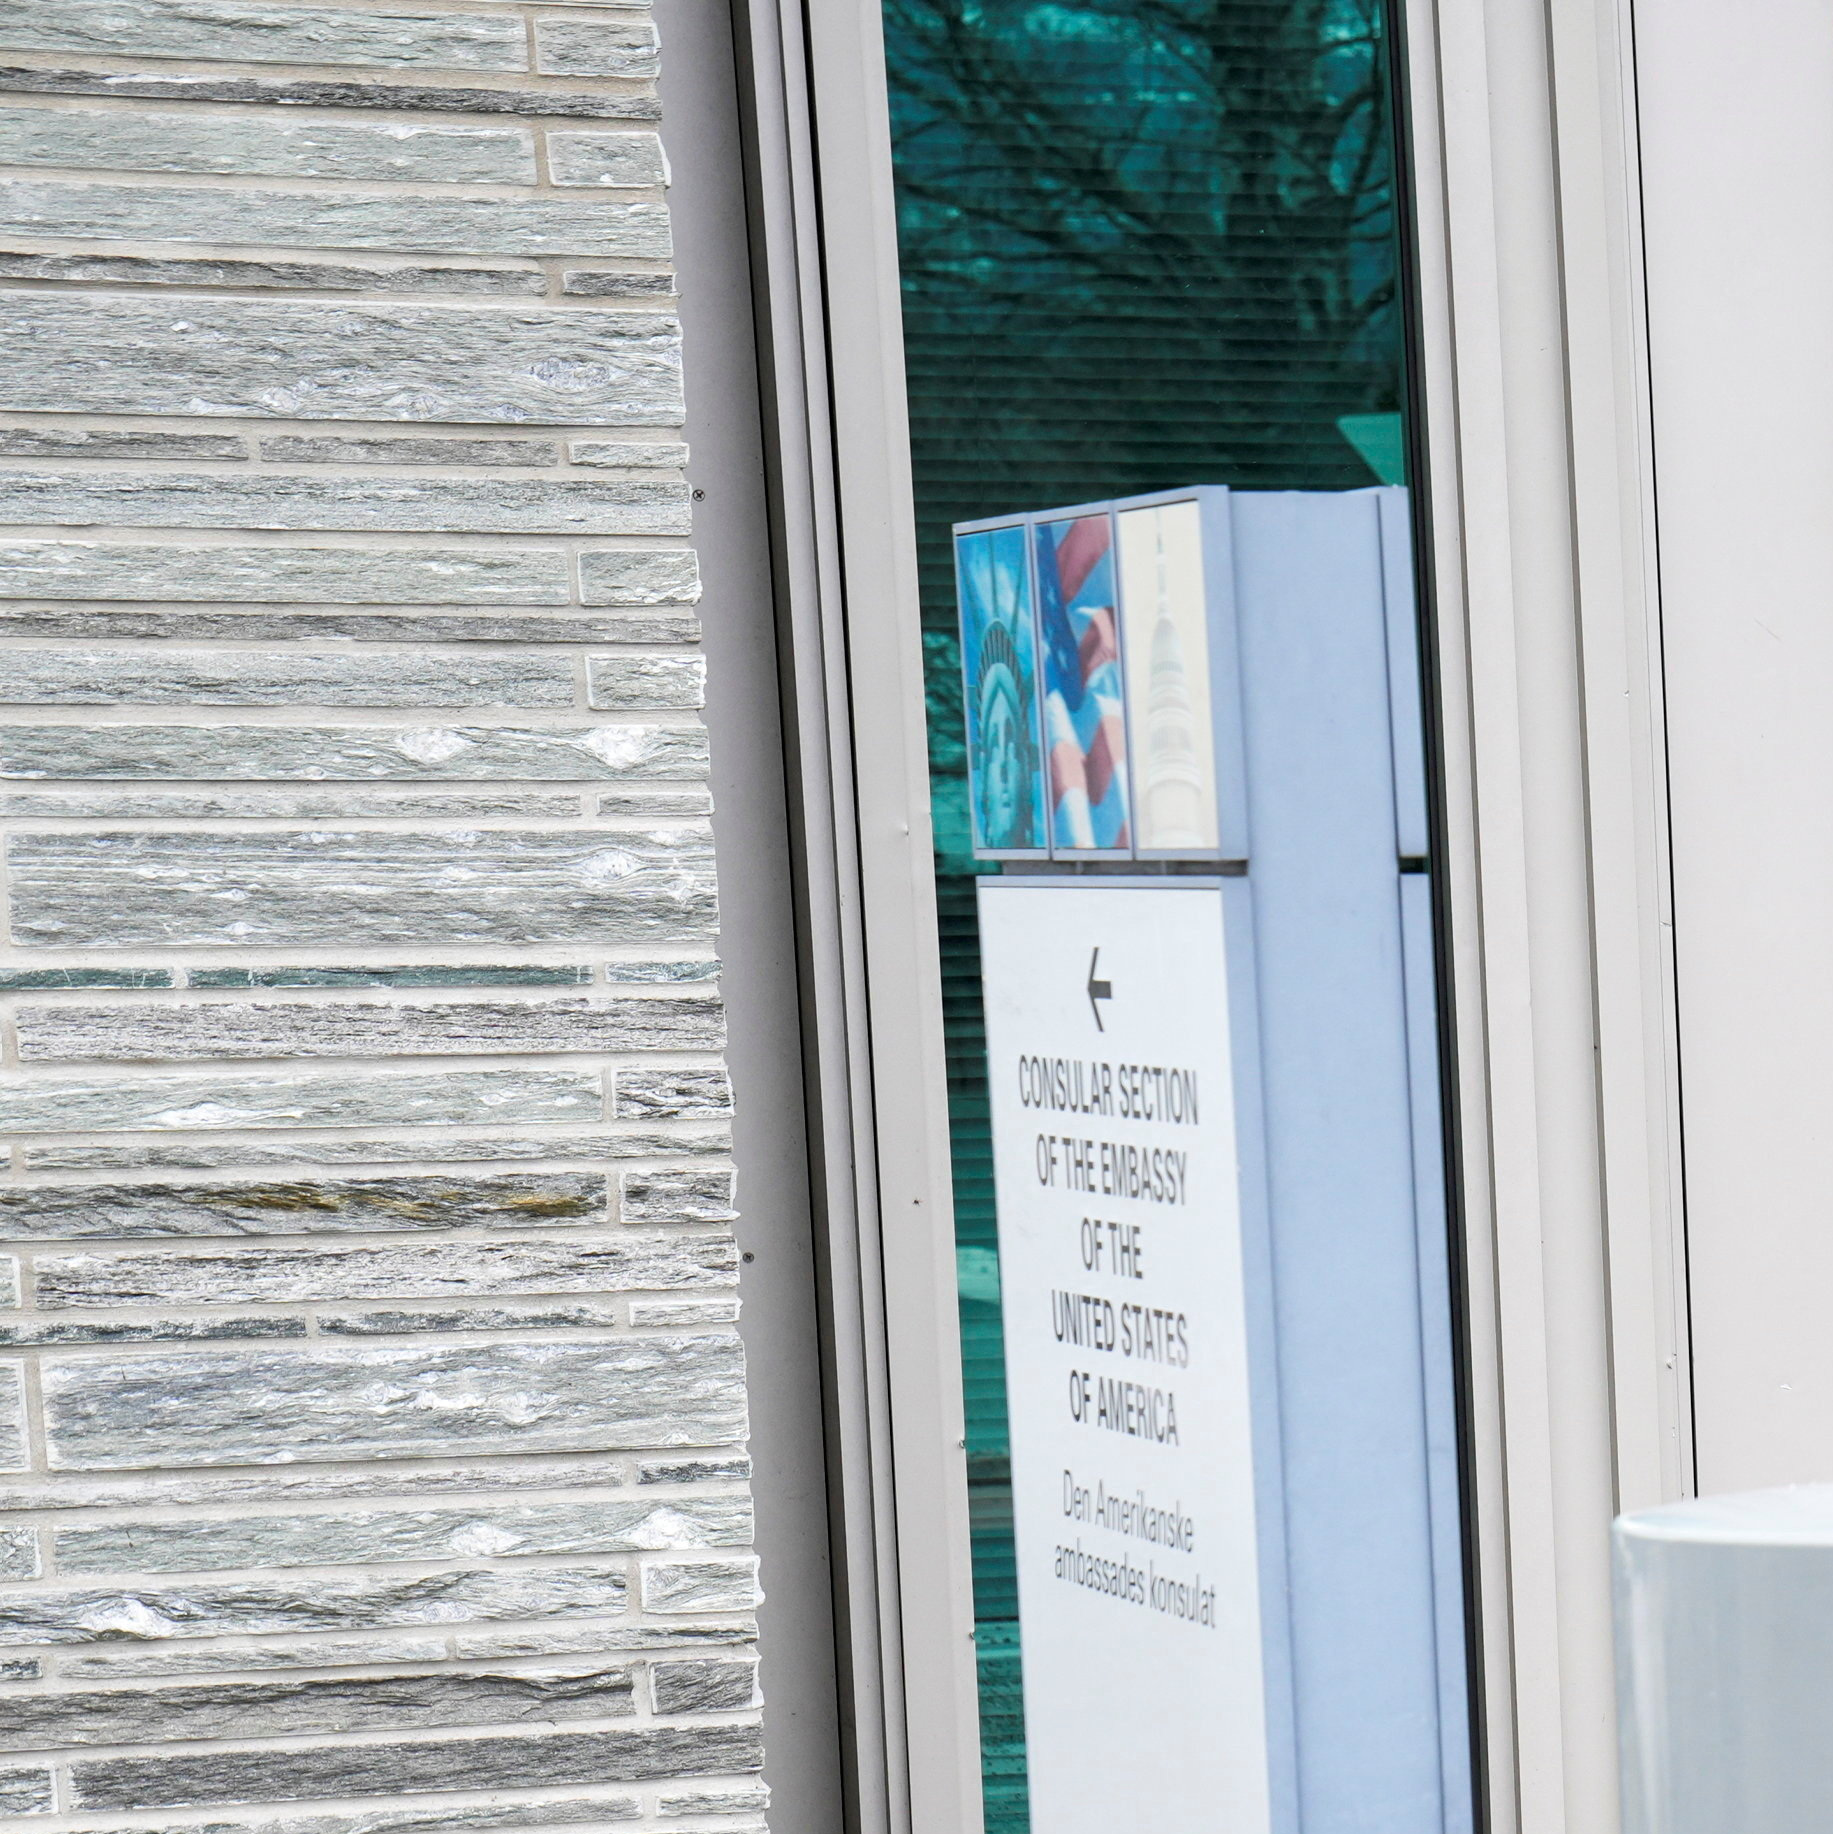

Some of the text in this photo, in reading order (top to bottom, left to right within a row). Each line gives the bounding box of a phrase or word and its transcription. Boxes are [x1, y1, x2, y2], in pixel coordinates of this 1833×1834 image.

[1018, 1054, 1199, 1125] CONSULAR SECTION
[1036, 1133, 1187, 1206] OF THE EMBASSY
[1081, 1217, 1143, 1279] OF THE
[1051, 1288, 1189, 1369] UNITED STATES
[1069, 1369, 1179, 1447] OF AMERICA
[1063, 1469, 1193, 1553] Den Amerikanske
[1055, 1536, 1216, 1629] ambassades konsulat
